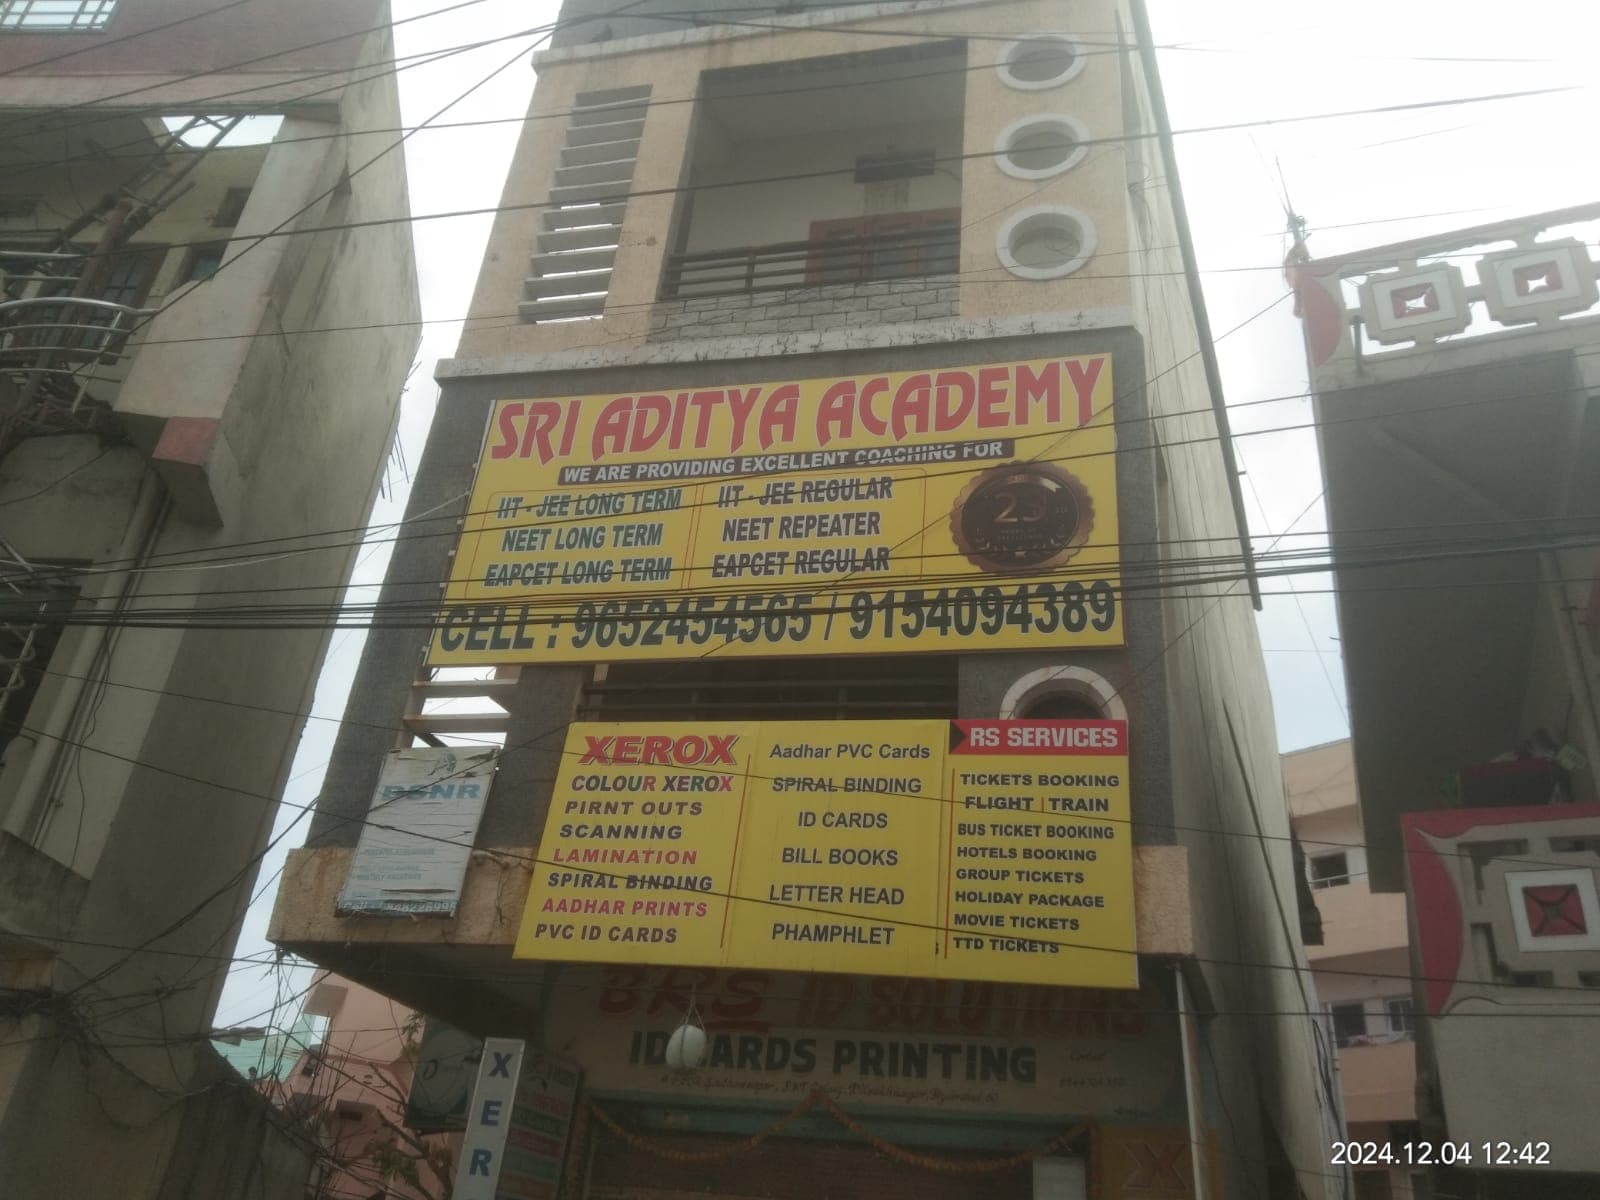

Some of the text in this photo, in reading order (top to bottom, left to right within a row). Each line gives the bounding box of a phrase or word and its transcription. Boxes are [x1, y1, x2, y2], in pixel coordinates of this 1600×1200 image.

[491, 357, 1105, 466] SRI ADITYA ACADEMY
[564, 440, 1003, 483] WE ARE PROVIDING EXCELLENT COACHING FOR
[758, 482, 795, 506] JEE
[800, 476, 893, 503] REGULAR
[536, 494, 571, 517] JEE
[574, 492, 625, 516] LONG
[632, 489, 682, 512] TERM
[722, 511, 881, 542] NEET REPEATER
[501, 523, 664, 552] NEET LONG TERM
[484, 557, 672, 586] EAPCET LONG TERM
[711, 547, 890, 578] EAPCET REGULAR
[440, 604, 535, 651] CELL
[571, 593, 813, 649] 9652454565
[849, 580, 1116, 640] 9154094389
[970, 727, 1118, 747] RS SERVICES
[578, 735, 741, 766] XEROX
[770, 744, 930, 759] Aadhar PVC Cards
[571, 775, 733, 792] COLOUR XEROX
[772, 777, 922, 793] SPIRAL BINDING
[960, 774, 1119, 787] TICKETS BOOKING
[564, 801, 703, 816] PIRNT OUTS
[965, 796, 1109, 811] FLIGHT TRAIN
[798, 812, 888, 829] ID CARDS
[560, 824, 682, 840] SCANNING
[958, 823, 1114, 839] BUS TICKET BOOKING
[553, 849, 697, 865] LAMINATION
[782, 847, 898, 866] BILL BOOKS
[957, 846, 1097, 861] HOTELS BOOKING
[548, 873, 713, 891] SPIRAL BINDING
[956, 869, 1084, 884] GROUP TICKETS
[769, 884, 904, 905] LETTER HEAD
[955, 891, 1104, 907] HOLIDAY PACKAGE
[541, 898, 707, 918] AADHAR PRINTS
[954, 914, 1079, 930] MOVIE TICKETS
[534, 923, 677, 943] PVC ID CARDS
[771, 923, 896, 945] PHAMPHLET
[953, 937, 1059, 953] TTD TICKETS
[832, 1040, 1037, 1083] PRINTING
[465, 1052, 513, 1200] XER
